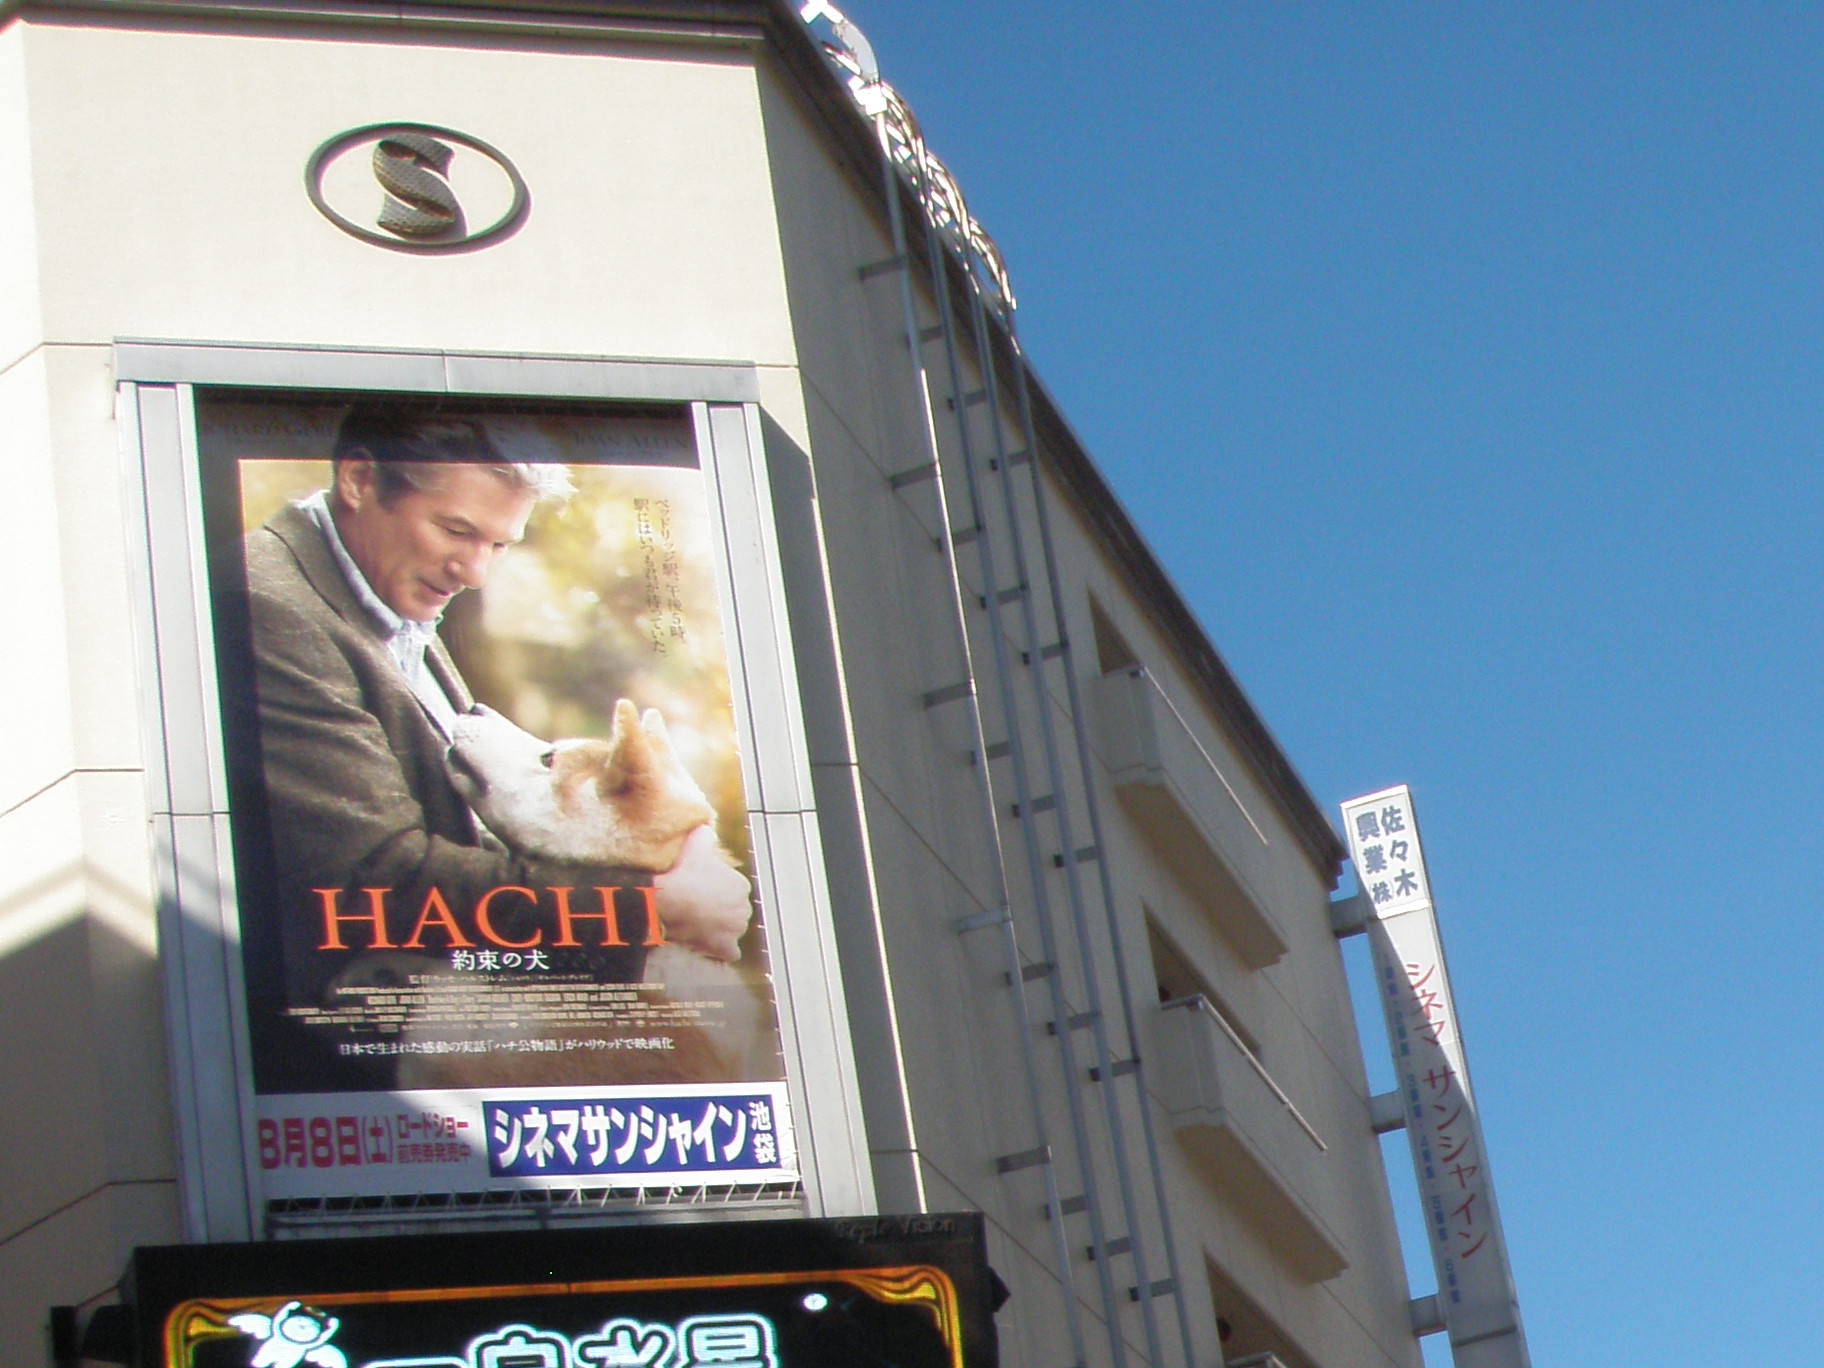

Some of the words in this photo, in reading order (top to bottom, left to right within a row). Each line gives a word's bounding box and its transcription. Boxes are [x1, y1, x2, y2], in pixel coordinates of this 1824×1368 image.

[1381, 806, 1417, 895] 佐々木
[313, 885, 666, 950] HACHI
[451, 949, 549, 972] 約束の犬
[1406, 962, 1446, 1048] シネマ
[257, 1115, 394, 1170] 8月8日(土)
[397, 1112, 470, 1139] ロードショー
[493, 1098, 748, 1169] シネマサンシャイン
[748, 1100, 778, 1165] 池袋
[1423, 1065, 1488, 1260] サンシャイン
